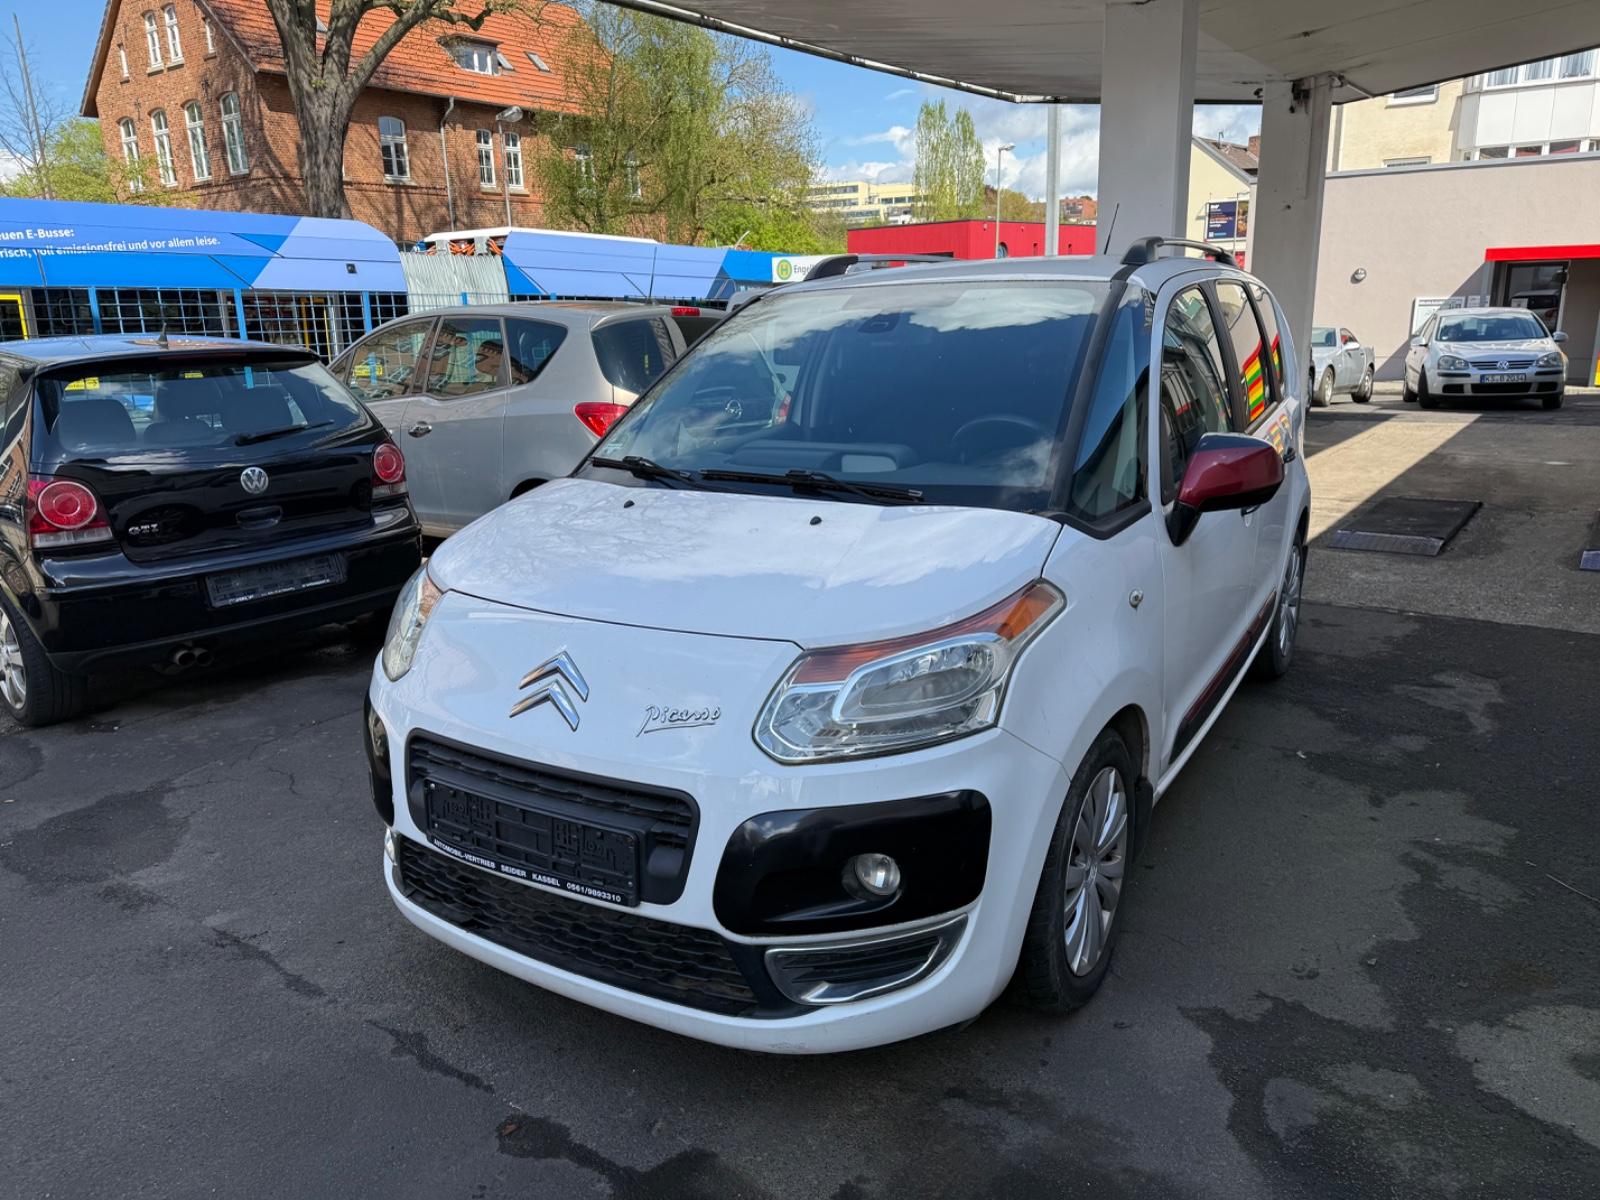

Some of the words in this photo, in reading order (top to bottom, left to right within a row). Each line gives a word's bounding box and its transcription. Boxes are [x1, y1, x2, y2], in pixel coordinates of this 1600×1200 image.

[25, 228, 75, 240] E-Busse:
[56, 241, 126, 255] emissionsfrei
[128, 240, 148, 250] und
[149, 240, 166, 249] vor
[168, 237, 194, 248] allem
[196, 236, 221, 246] leise.
[129, 523, 159, 535] GTI
[636, 704, 721, 737] Picasso
[500, 864, 527, 878] SEIDER
[531, 872, 561, 887] KASSEL
